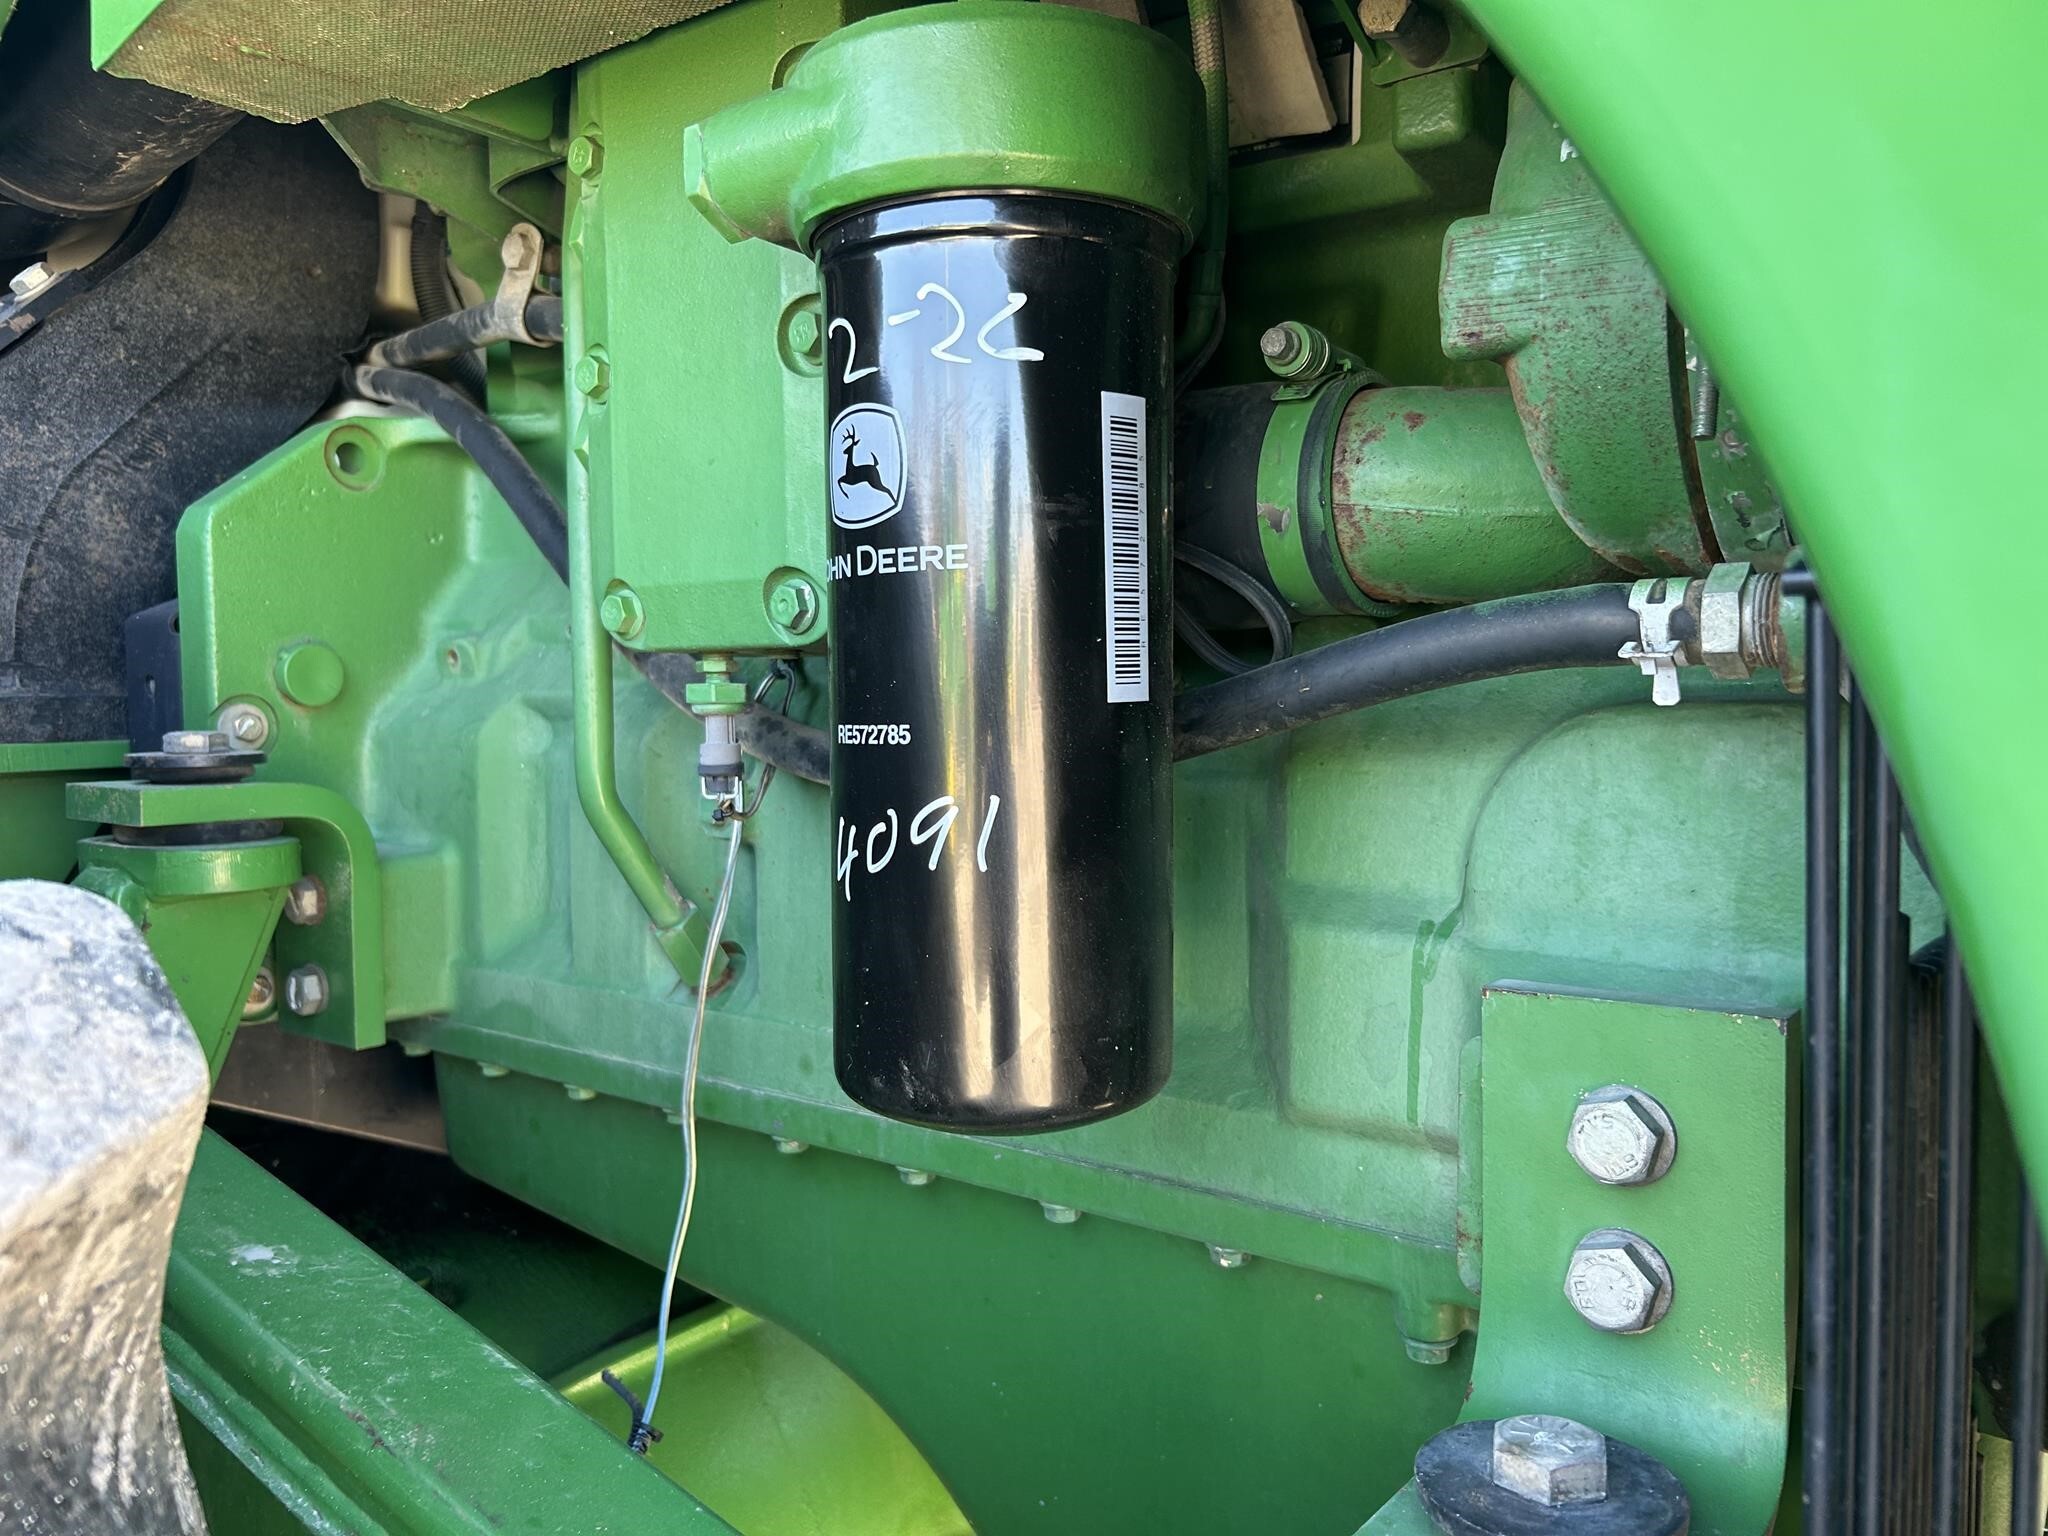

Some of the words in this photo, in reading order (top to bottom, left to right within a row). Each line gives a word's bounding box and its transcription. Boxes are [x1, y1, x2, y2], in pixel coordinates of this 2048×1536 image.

[857, 544, 969, 577] DEERE
[837, 724, 912, 746] RE572785
[836, 794, 1001, 902] 4091
